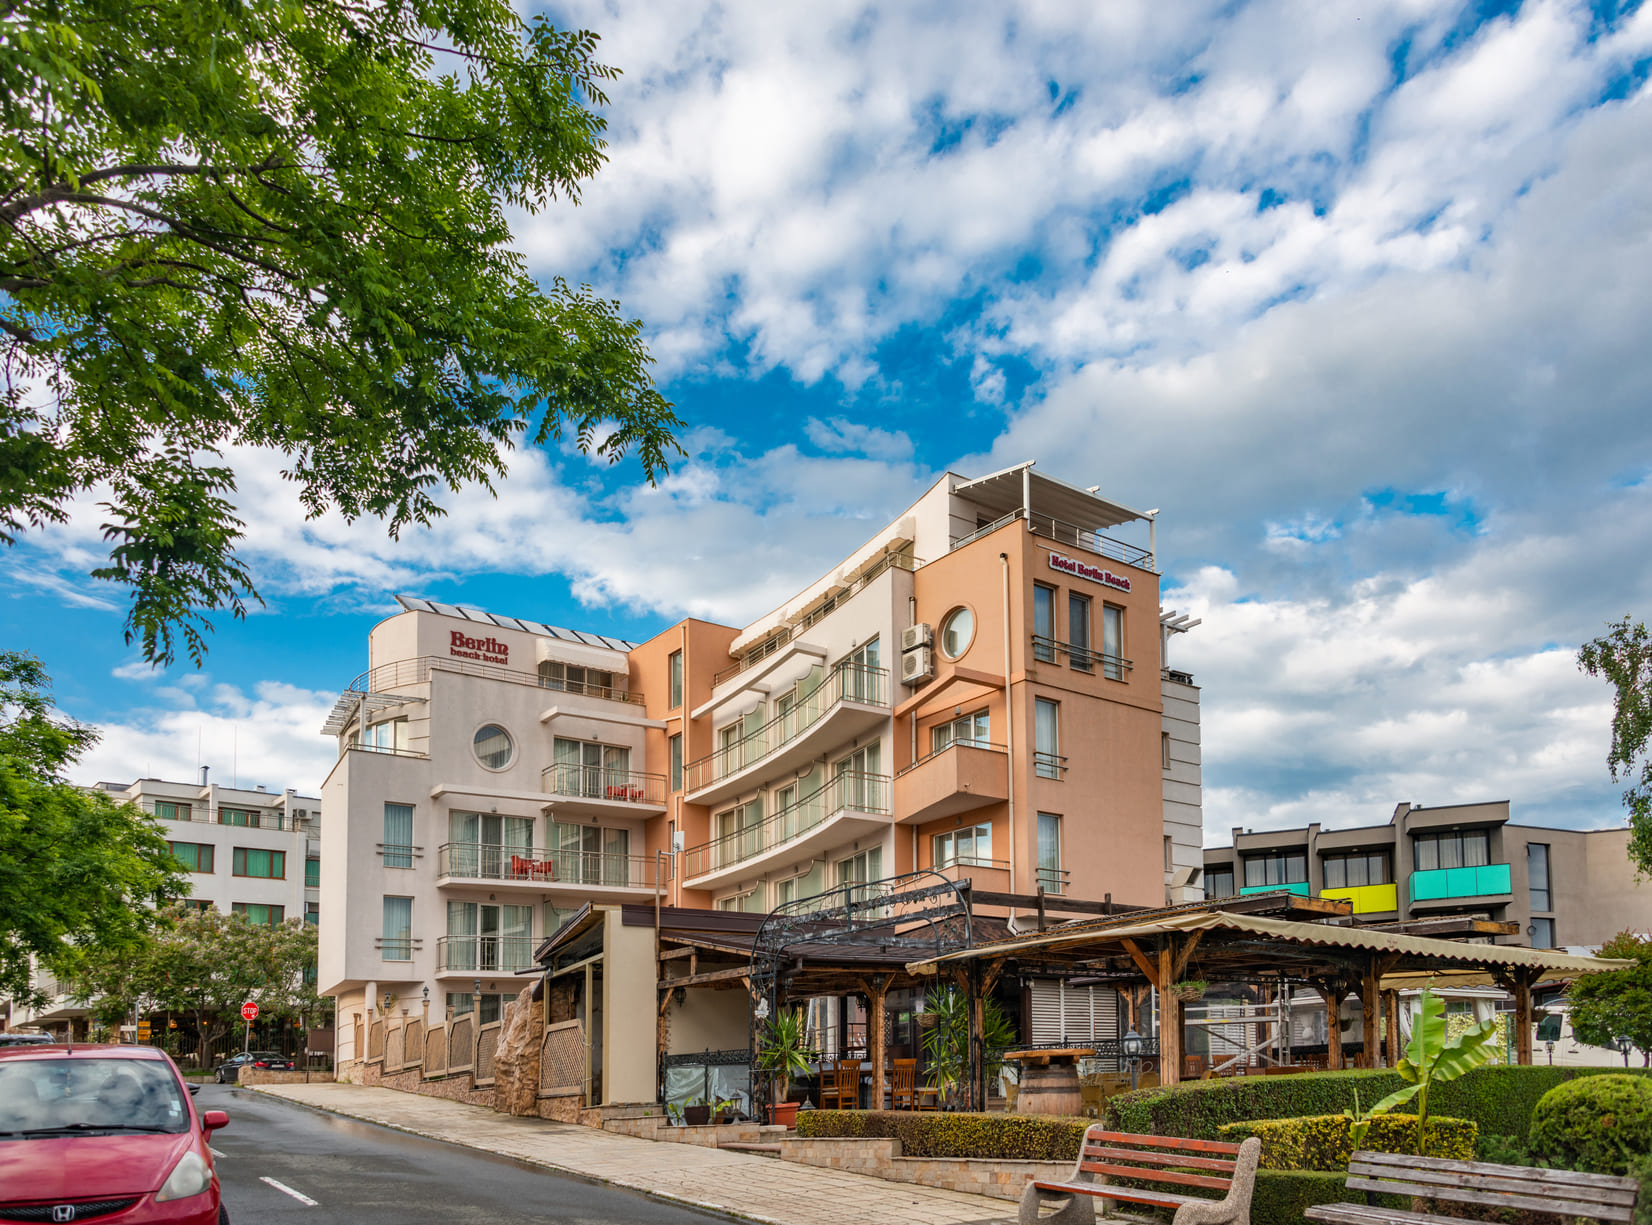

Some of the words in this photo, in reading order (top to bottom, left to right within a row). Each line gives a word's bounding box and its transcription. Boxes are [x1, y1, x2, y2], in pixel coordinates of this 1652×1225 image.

[1051, 554, 1076, 573] Hotel
[1077, 563, 1104, 581] Berlin
[1104, 571, 1131, 591] Beach
[450, 630, 509, 656] Berlin
[450, 646, 480, 660] beach
[482, 652, 508, 666] hotel
[243, 1007, 257, 1015] STOP
